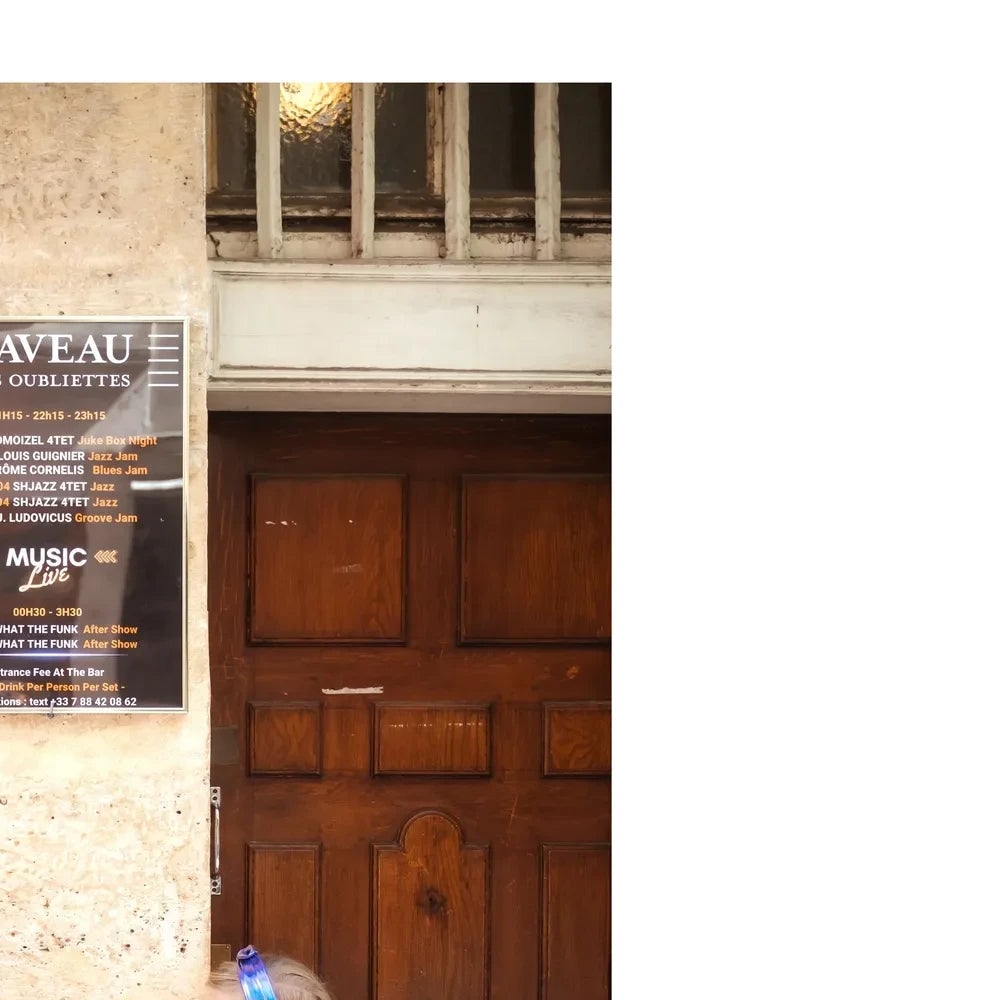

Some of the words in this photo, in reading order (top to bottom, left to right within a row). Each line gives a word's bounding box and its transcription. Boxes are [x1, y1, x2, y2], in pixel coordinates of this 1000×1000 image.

[9, 374, 130, 387] OUBLIETTES
[33, 411, 64, 420] 22h15
[74, 411, 106, 420] 23h15
[47, 436, 74, 445] 4TET
[78, 436, 103, 445] Juke
[106, 436, 125, 445] Box
[129, 436, 157, 447] Night
[33, 452, 85, 461] GUIGNIER
[88, 452, 113, 461] Jazz
[115, 452, 138, 461] Jam
[30, 466, 84, 475] CORNELIS
[92, 466, 122, 475] Blues
[125, 466, 147, 475] Jam
[13, 482, 57, 491] SHJAZZ
[60, 482, 87, 491] 4TET
[90, 482, 114, 491] Jazz
[13, 498, 57, 507] SHJAZZ
[61, 498, 89, 507] 4TET
[92, 498, 118, 507] Jazz
[9, 513, 72, 523] LUDOVICUS
[75, 513, 112, 523] Groove
[115, 513, 137, 523] Jam
[6, 548, 87, 566] MUSIC
[19, 565, 70, 592] Live
[13, 608, 45, 617] 00H30
[56, 608, 82, 617] 3H30
[27, 625, 48, 634] THE
[50, 625, 78, 634] FUNK
[84, 625, 109, 634] After
[111, 625, 138, 634] Show
[27, 640, 48, 648] THE
[50, 640, 78, 648] FUNK
[84, 639, 109, 648] After
[111, 639, 138, 648] Show
[33, 668, 50, 677] Fee
[53, 668, 64, 677] At
[67, 668, 85, 677] The
[88, 668, 104, 677] Bar
[0, 682, 24, 691] Drink
[27, 683, 43, 691] Per
[46, 683, 80, 691] Person
[83, 683, 99, 691] Per
[102, 683, 118, 691] Set
[29, 698, 48, 706] text
[71, 697, 77, 706] 7
[80, 697, 92, 706] 88
[95, 697, 107, 706] 42
[110, 697, 122, 706] 08
[124, 697, 136, 706] 62
